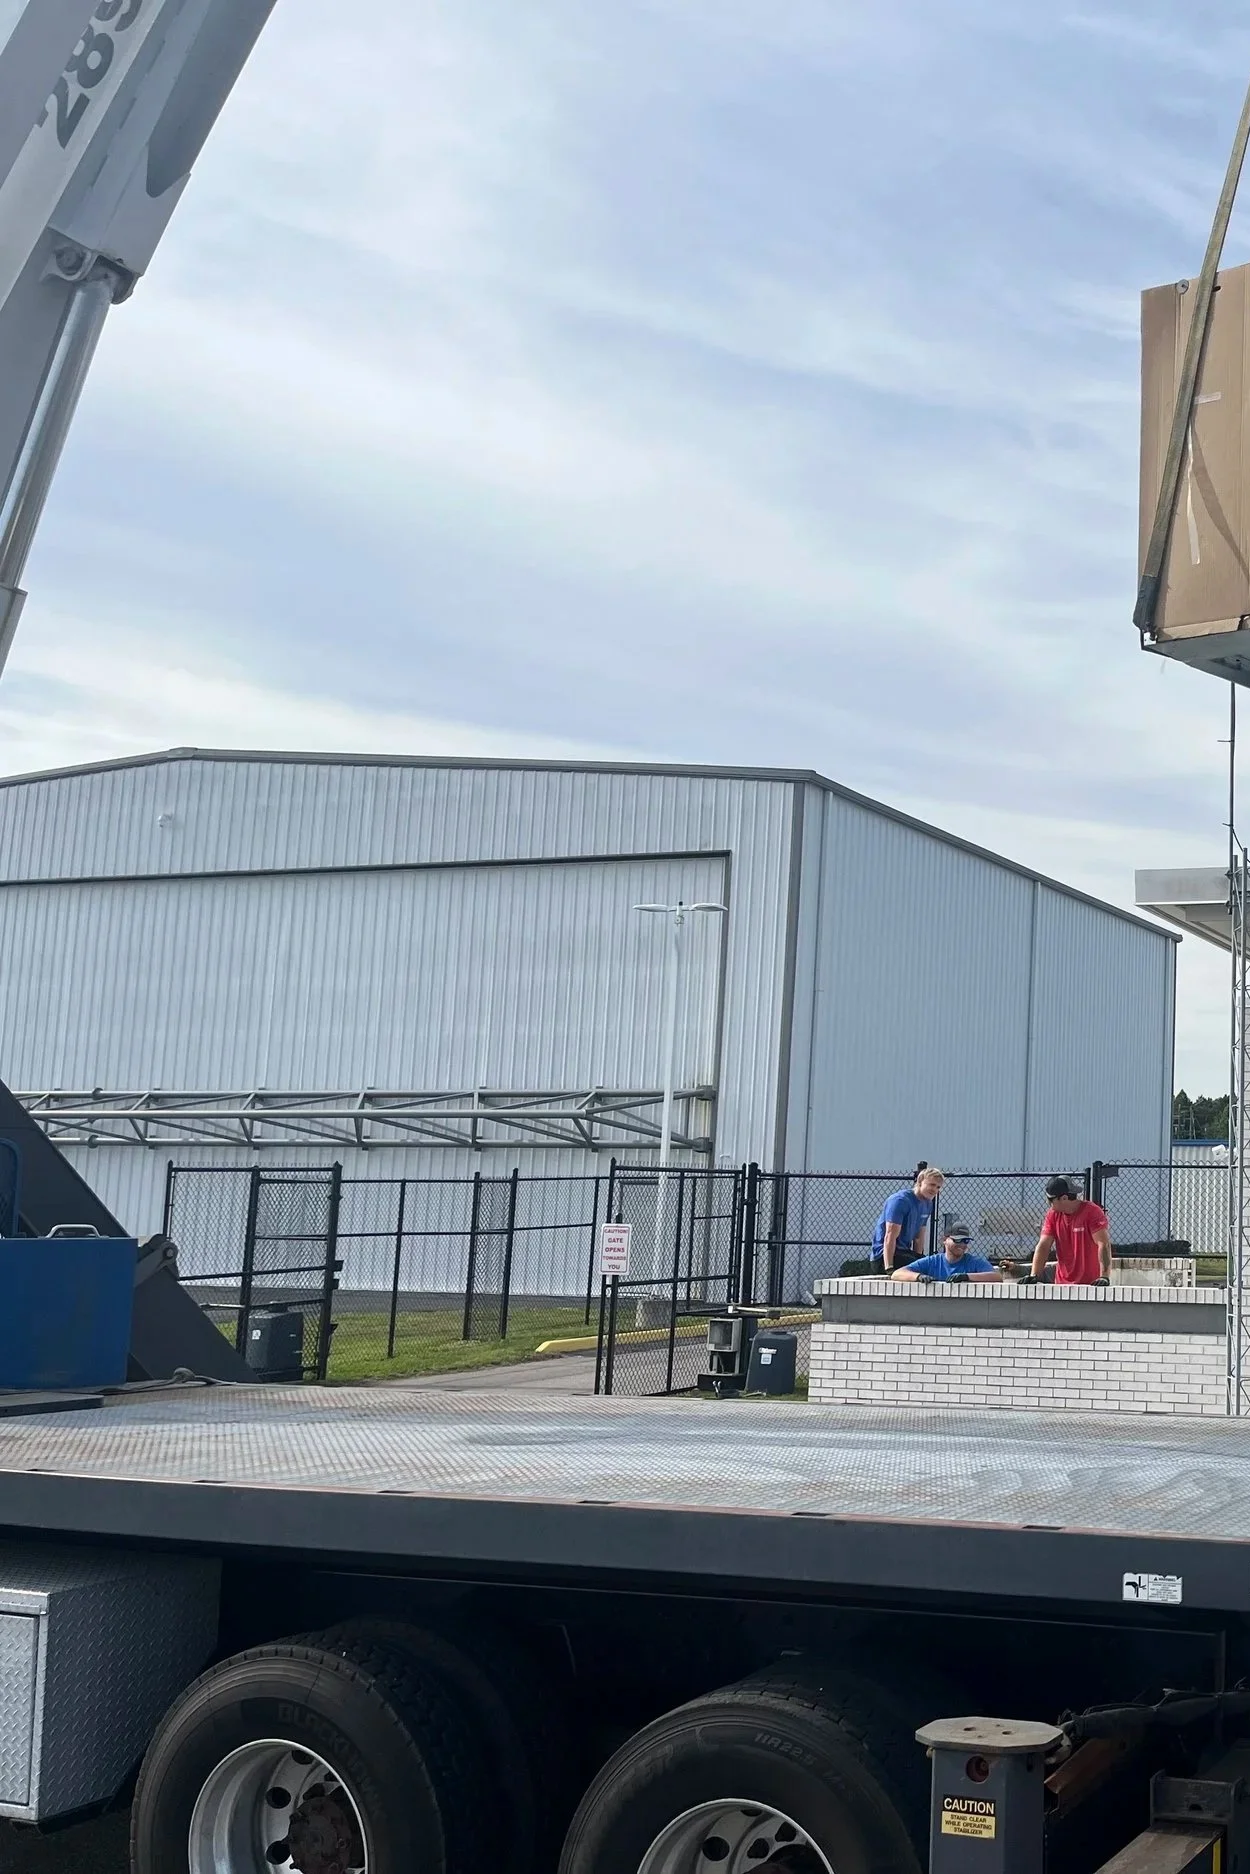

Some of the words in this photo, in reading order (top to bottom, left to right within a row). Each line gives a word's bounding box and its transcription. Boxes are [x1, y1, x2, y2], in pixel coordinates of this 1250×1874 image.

[944, 1798, 994, 1814] CAUTION
[963, 1821, 992, 1830] OPERATING
[954, 1827, 982, 1835] STABILIZER
